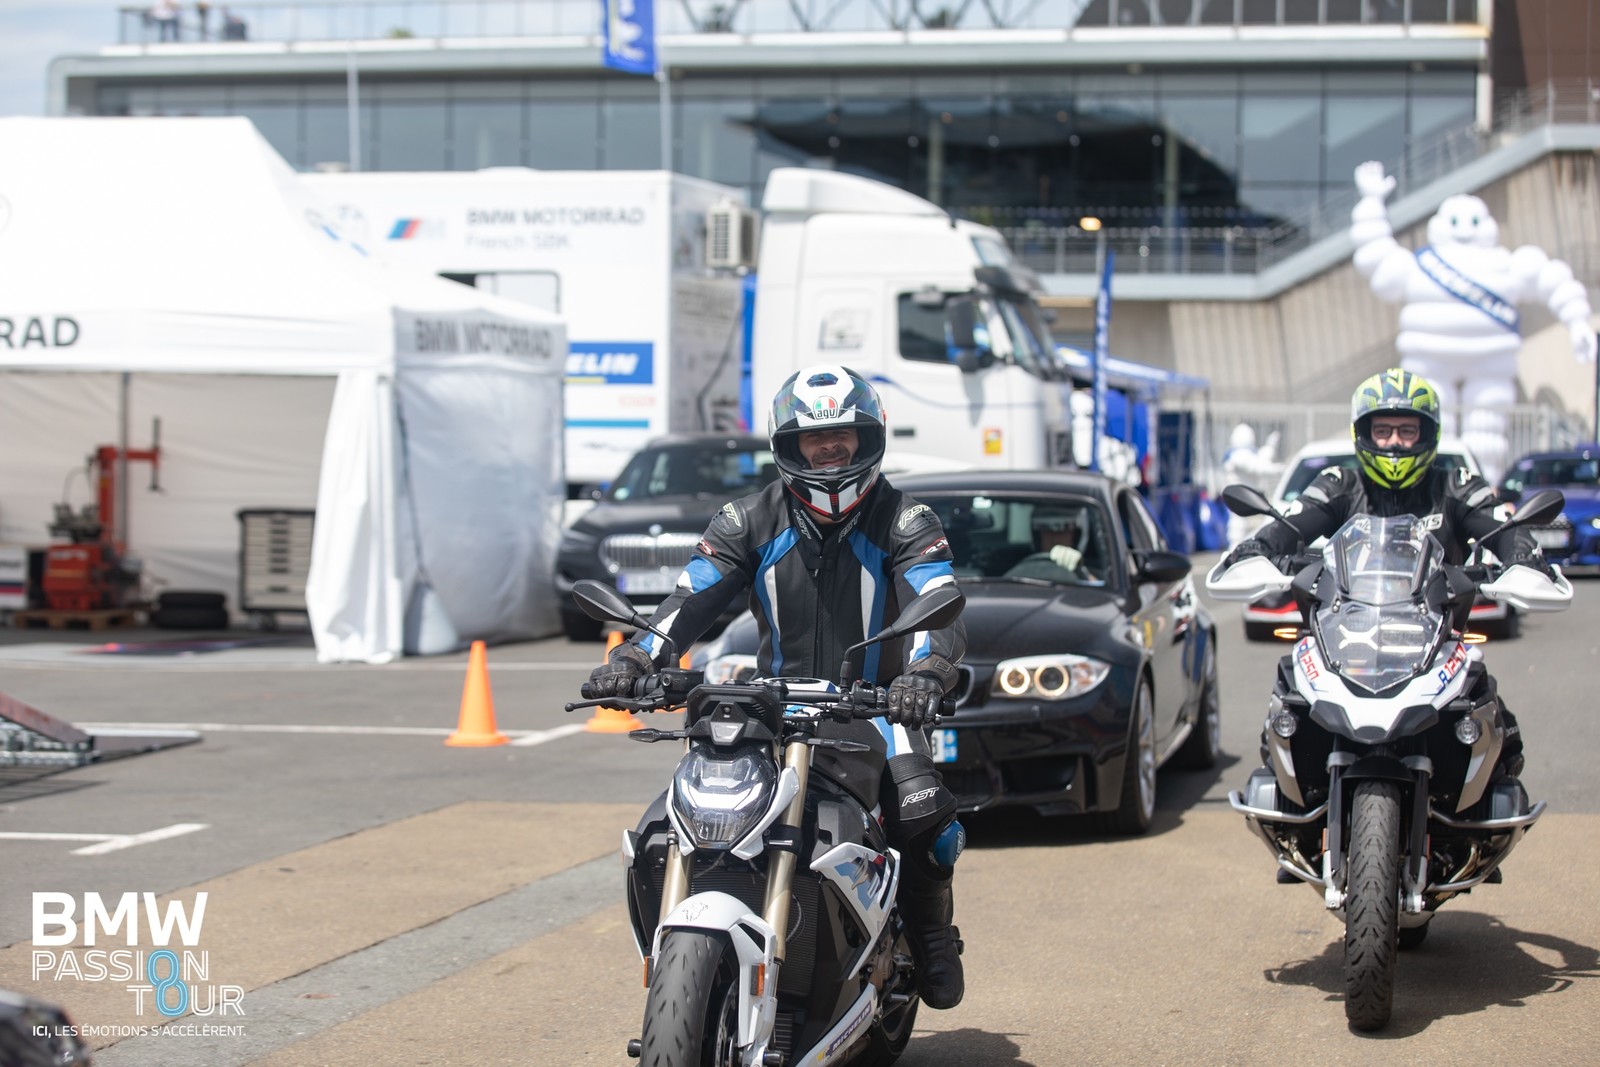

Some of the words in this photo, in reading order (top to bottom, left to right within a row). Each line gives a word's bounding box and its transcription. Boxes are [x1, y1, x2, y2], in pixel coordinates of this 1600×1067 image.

[522, 206, 644, 225] MOTORRAD
[817, 409, 836, 419] agv
[901, 786, 940, 807] RST
[833, 1003, 870, 1050] MICHELIN
